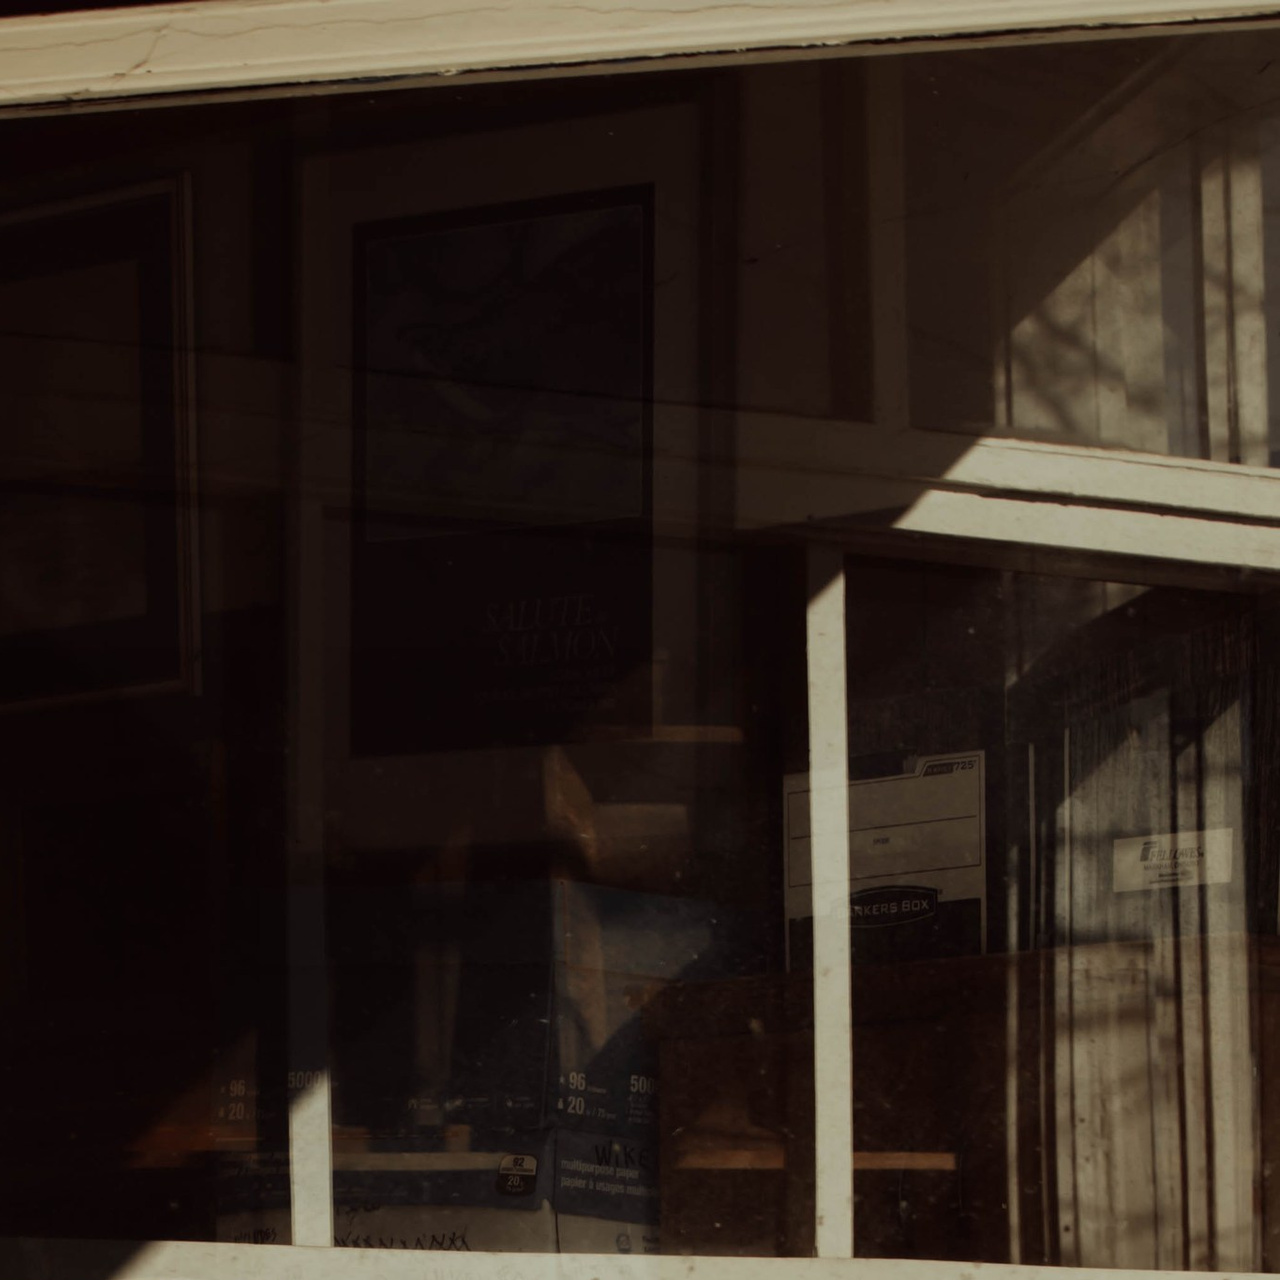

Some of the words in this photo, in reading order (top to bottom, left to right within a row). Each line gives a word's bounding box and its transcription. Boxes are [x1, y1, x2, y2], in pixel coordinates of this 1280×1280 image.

[493, 624, 619, 668] SALMON
[901, 899, 930, 913] BOX
[230, 1080, 245, 1097] 96
[569, 1072, 586, 1091] 96
[228, 1103, 244, 1120] 20
[567, 1096, 585, 1115] 20
[561, 1159, 615, 1177] multipurpose
[616, 1168, 640, 1180] paper
[507, 1176, 520, 1186] 20
[596, 1181, 625, 1195] usages
